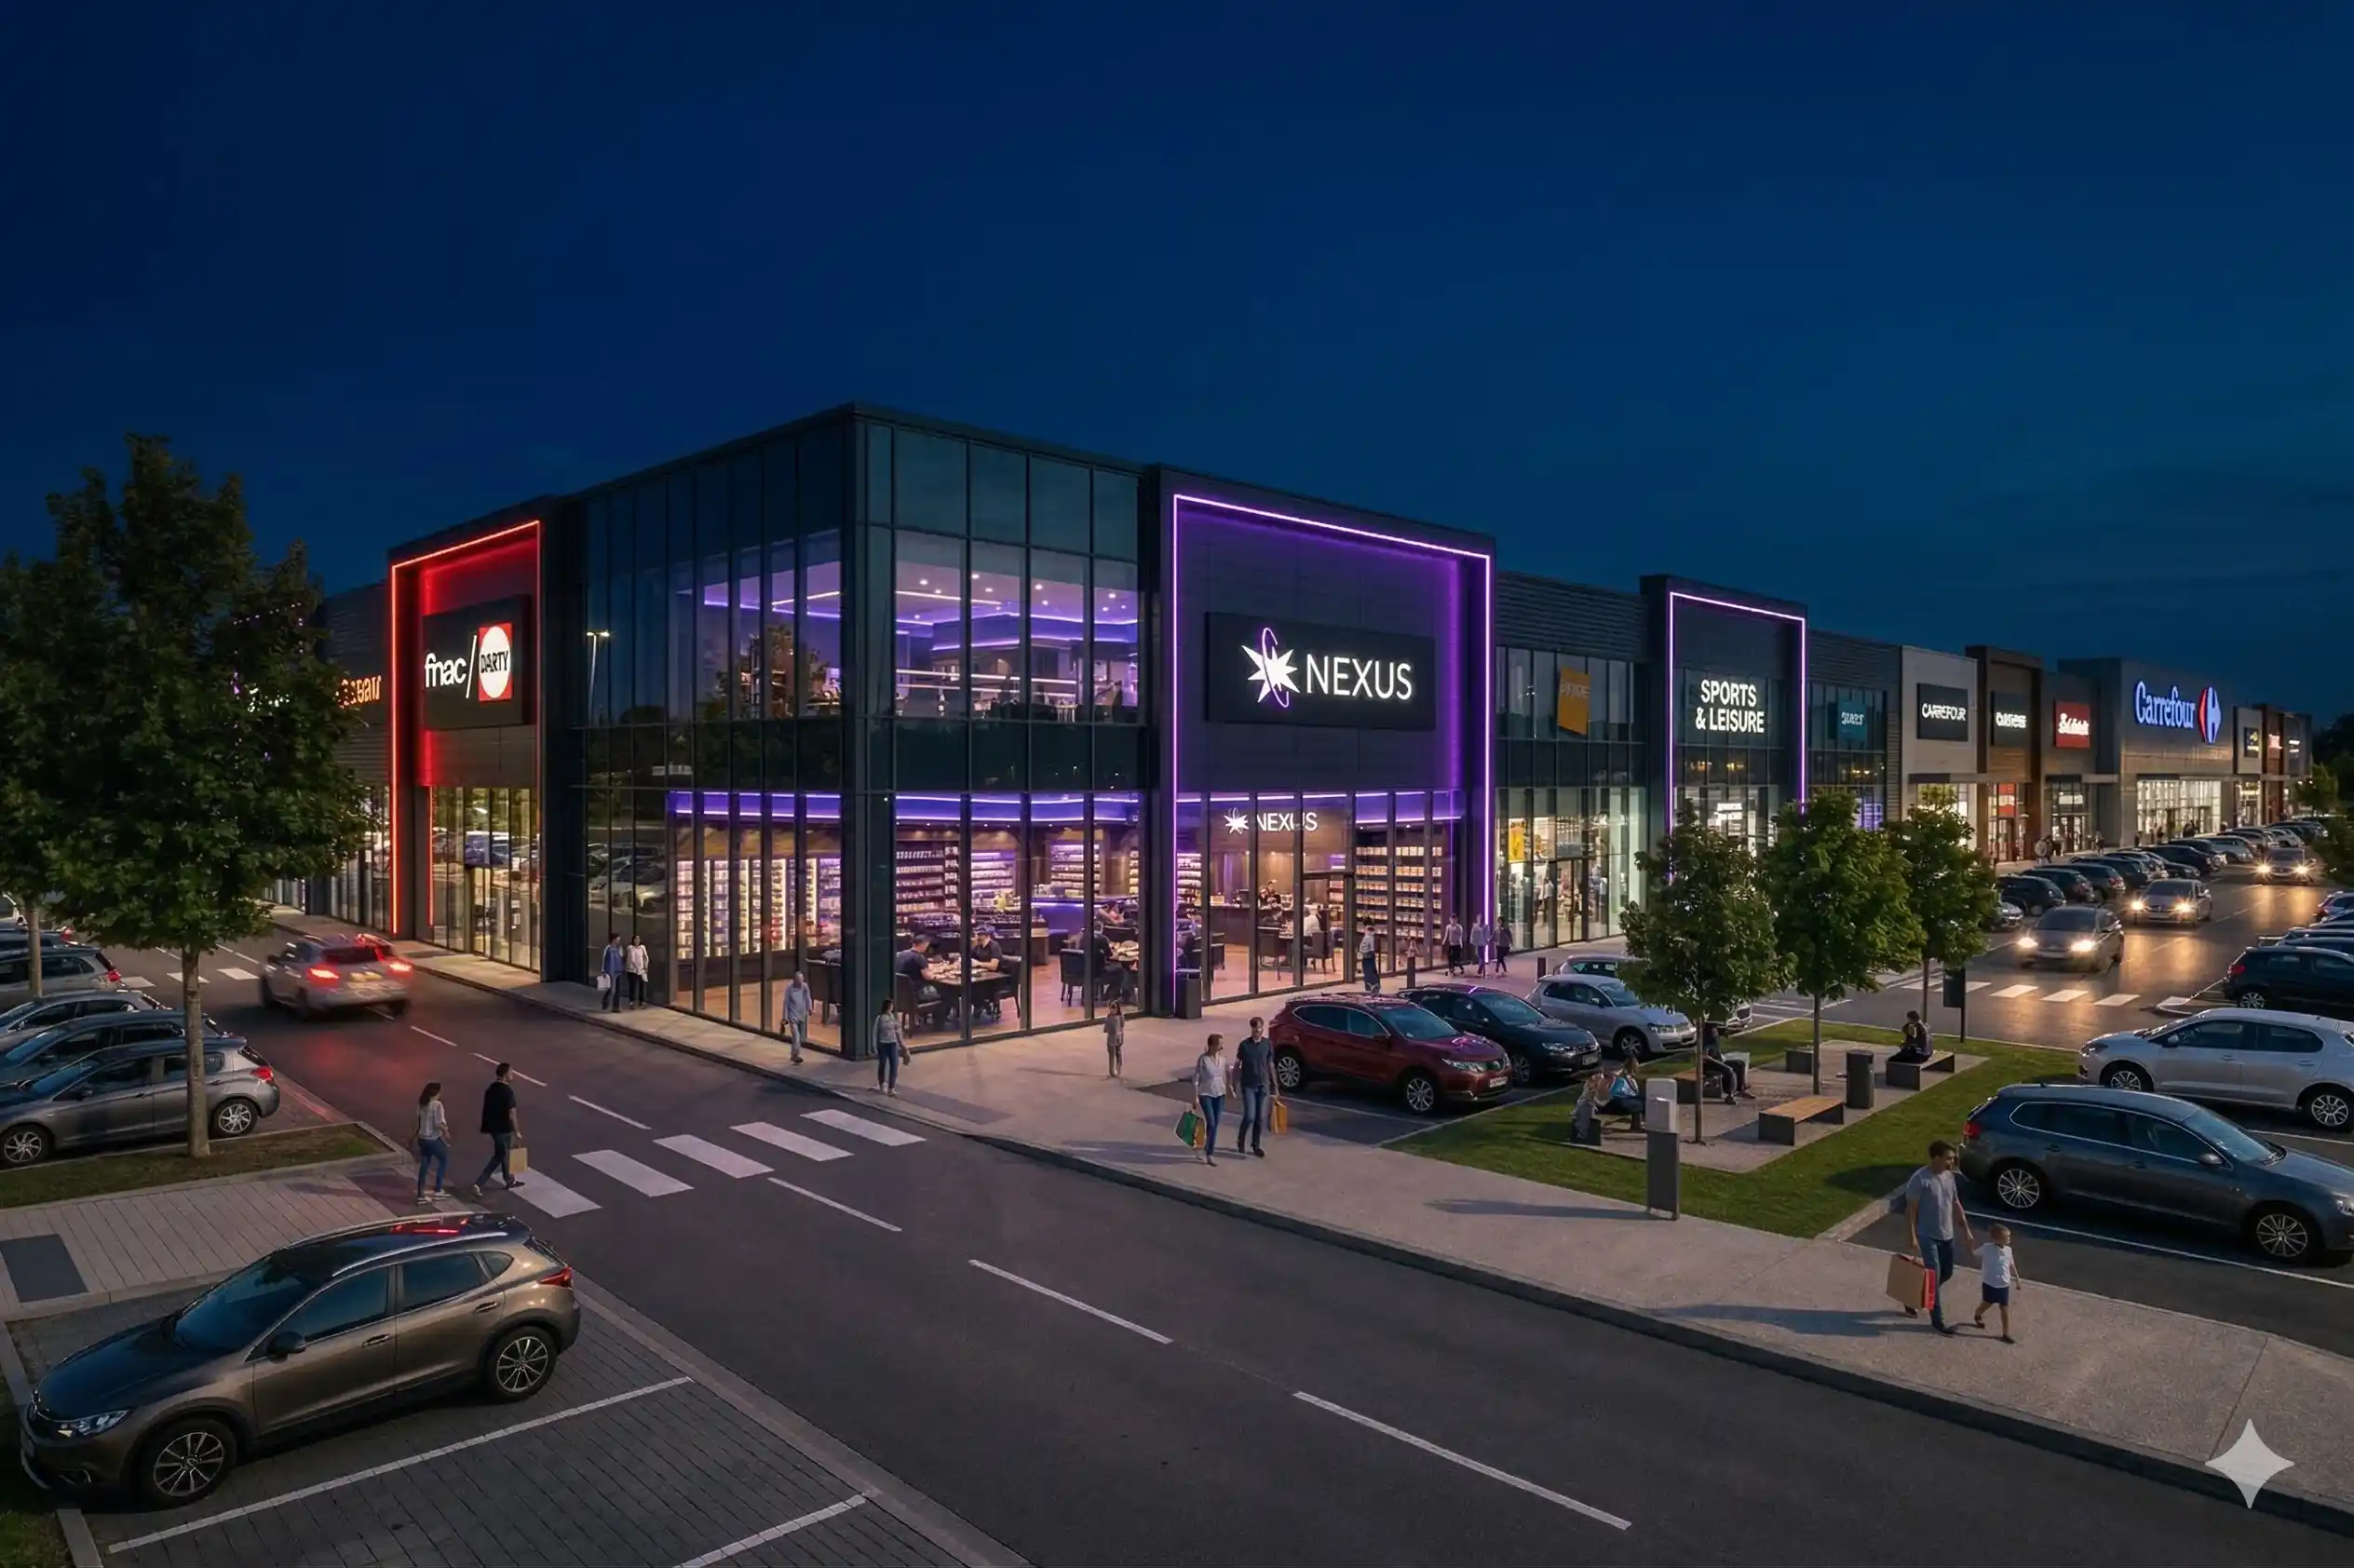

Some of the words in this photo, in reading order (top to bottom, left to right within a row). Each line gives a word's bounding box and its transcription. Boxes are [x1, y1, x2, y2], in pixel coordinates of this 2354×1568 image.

[480, 651, 509, 674] DARTY
[1306, 654, 1413, 700] NEXUS
[1700, 679, 1757, 708] SPORTS
[2135, 681, 2196, 729] Carrefour
[1696, 707, 1707, 730] &
[1710, 708, 1765, 734] LEISURE
